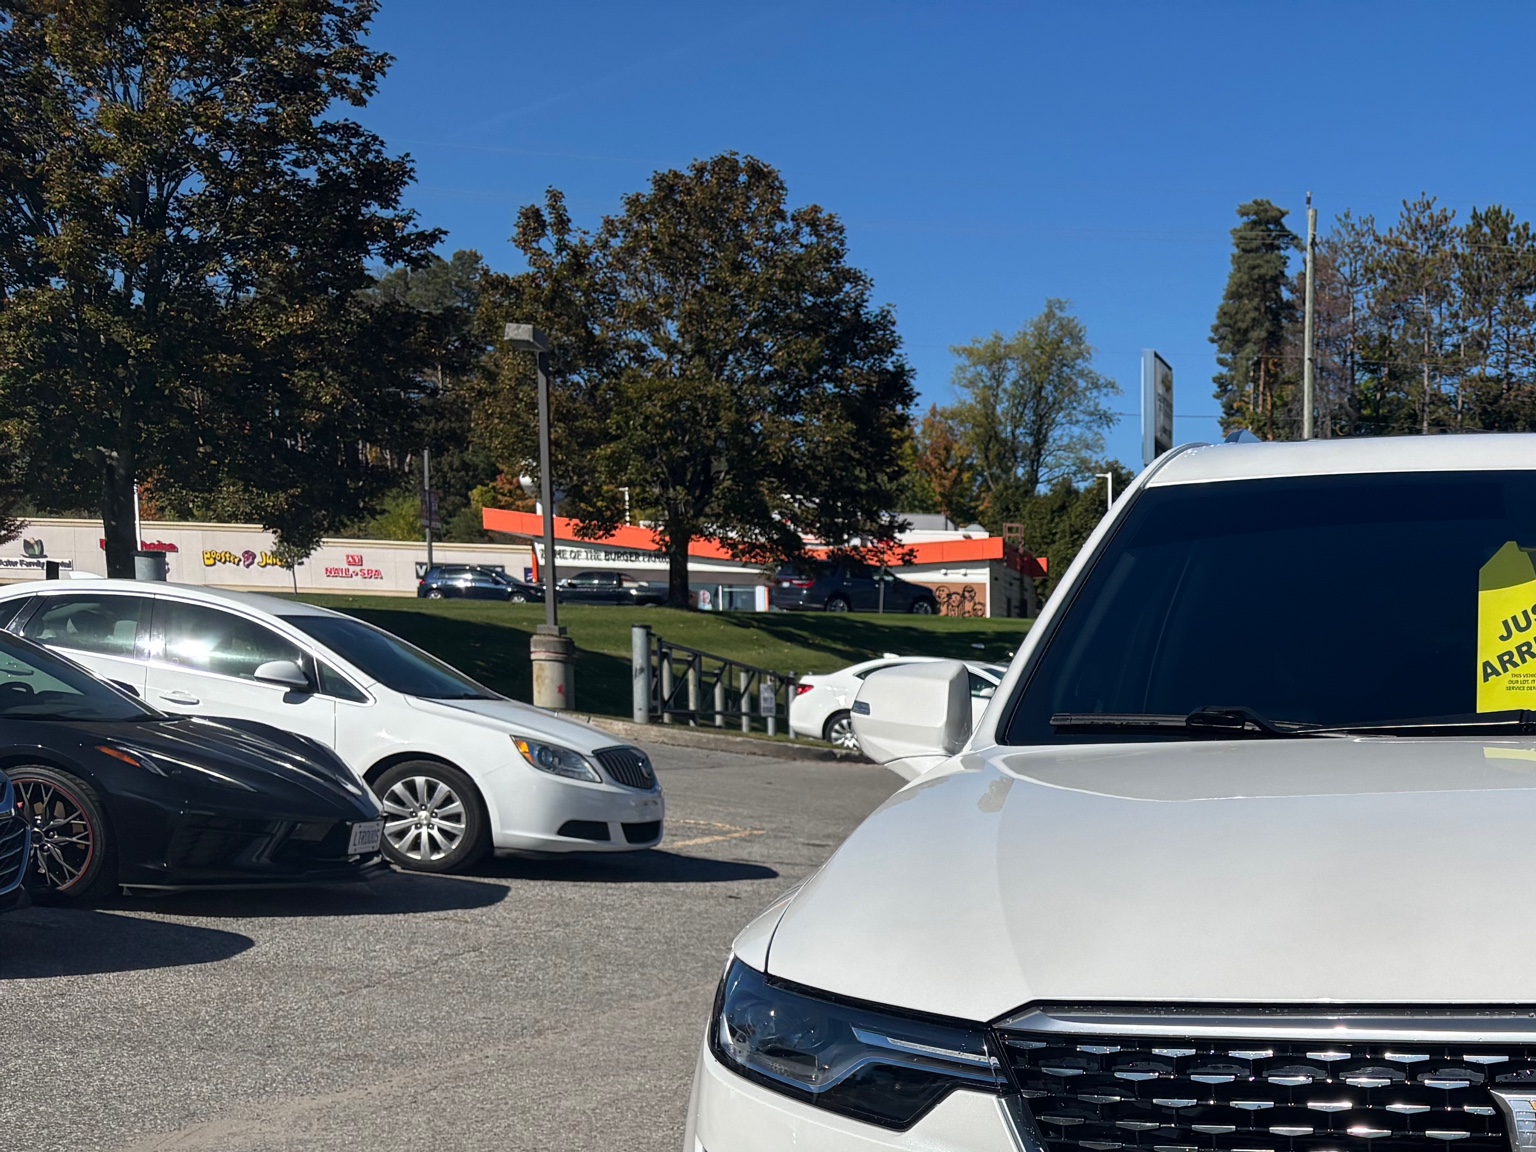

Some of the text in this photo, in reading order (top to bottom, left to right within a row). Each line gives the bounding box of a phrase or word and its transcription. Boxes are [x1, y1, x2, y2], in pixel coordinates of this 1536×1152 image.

[202, 550, 242, 566] Booster
[604, 550, 640, 562] BURGER
[325, 567, 382, 579] NAIL SPA
